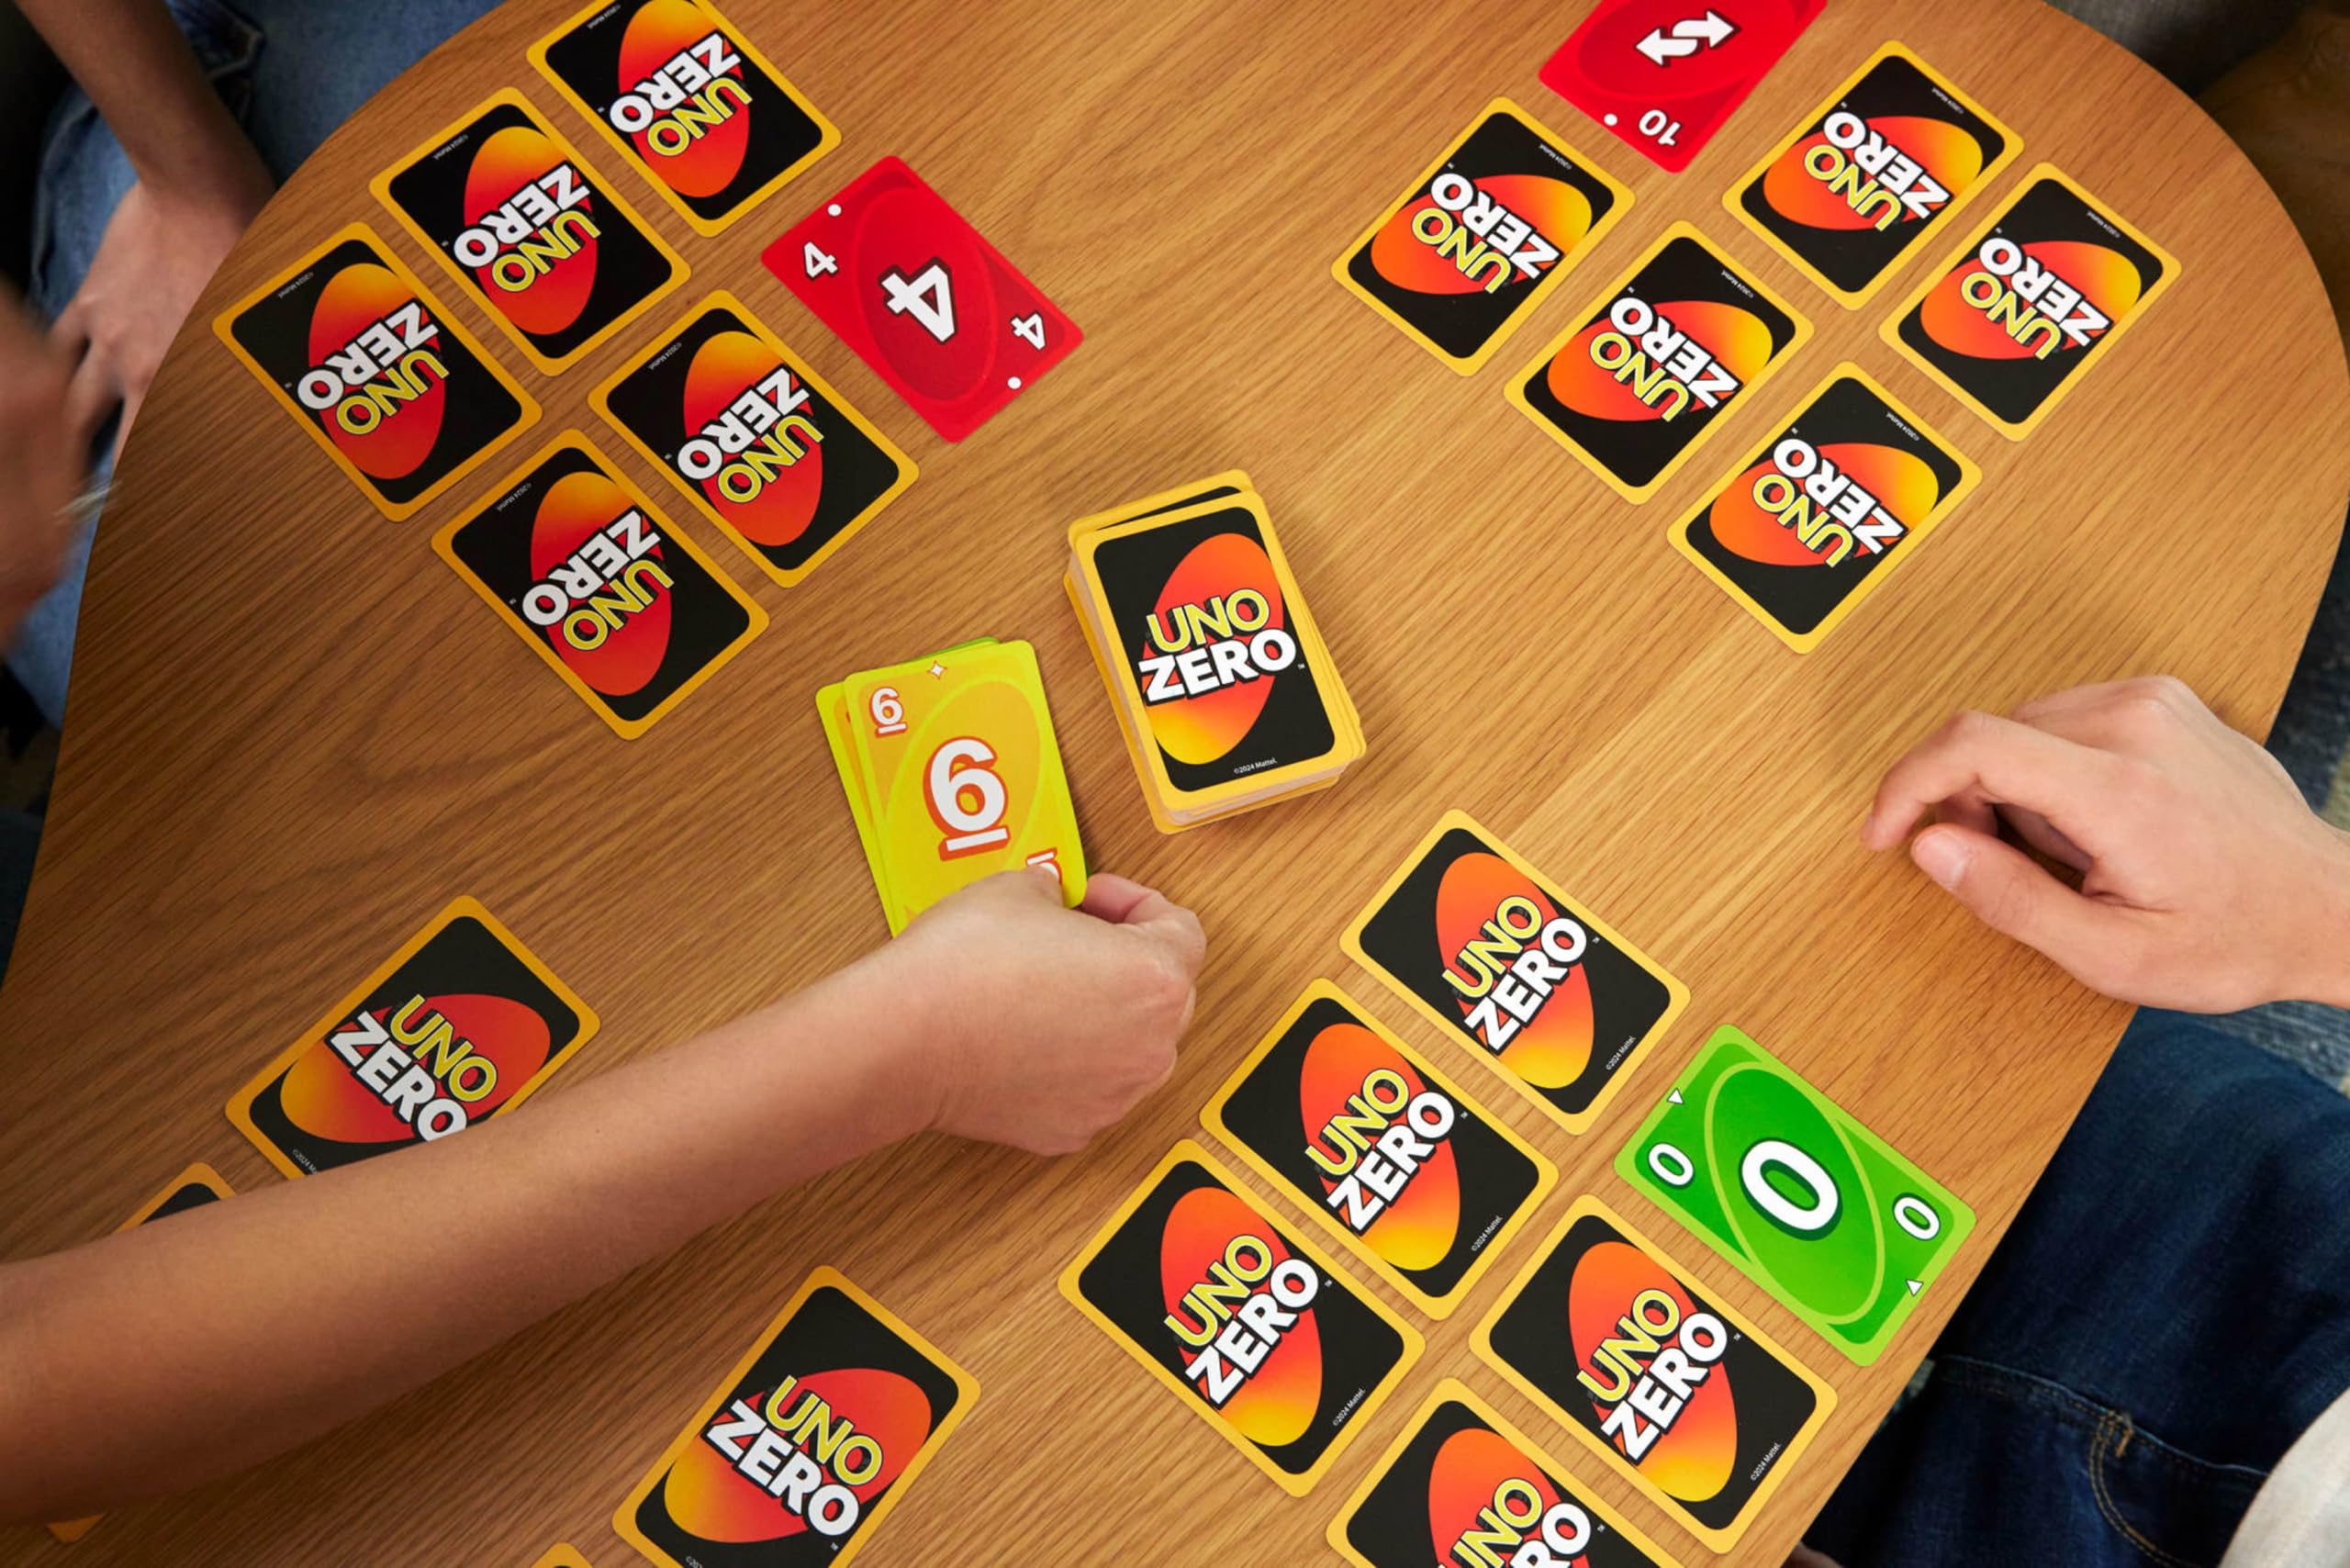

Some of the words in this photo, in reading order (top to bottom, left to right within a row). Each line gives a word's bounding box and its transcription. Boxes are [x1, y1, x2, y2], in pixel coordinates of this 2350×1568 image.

[609, 32, 742, 133] ZERO
[646, 76, 751, 157] UNO
[1638, 108, 1682, 147] 10
[1804, 144, 1902, 233] UNO
[1823, 111, 1951, 220] ZERO
[453, 163, 591, 268] ZERO
[491, 209, 601, 293] UNO
[804, 242, 837, 277] 4
[1412, 207, 1511, 293] UNO
[1429, 172, 1561, 280] ZERO
[881, 264, 955, 342] 4
[1011, 313, 1046, 349] 4
[1961, 271, 2061, 359] UNO
[1978, 237, 2110, 347] ZERO
[297, 302, 439, 410] ZERO
[336, 350, 450, 434] UNO
[1590, 331, 1689, 421] UNO
[1609, 297, 1740, 409] ZERO
[677, 367, 811, 480] ZERO
[717, 414, 823, 504] UNO
[1752, 474, 1853, 566] UNO
[1773, 437, 1905, 555] ZERO
[521, 510, 661, 626] ZERO
[562, 557, 673, 652] UNO
[1137, 628, 1297, 703] ZERO
[1147, 588, 1270, 653] UNO
[871, 687, 907, 735] 6
[929, 737, 1009, 853] 6
[1234, 764, 1255, 773] ©2024
[1255, 757, 1277, 767] Mattel.
[1443, 896, 1541, 998] UNO
[1462, 917, 1588, 1051] ZERO
[330, 1010, 469, 1143] ZERO
[390, 994, 497, 1102] UNO
[1606, 1053, 1621, 1070] ©2024
[1305, 1069, 1409, 1176] UNO
[1326, 1091, 1456, 1231] ZERO
[1649, 1143, 1694, 1185] 0
[1741, 1140, 1838, 1230] 0
[1894, 1197, 1940, 1239] 0
[1472, 1233, 1487, 1250] ©2024
[1164, 1235, 1272, 1347] UNO
[1184, 1258, 1320, 1406] ZERO
[1578, 1290, 1680, 1402] UNO
[1599, 1312, 1729, 1461] ZERO
[765, 1374, 883, 1486] UNO
[1333, 1406, 1349, 1426] ©2024
[706, 1398, 860, 1537] ZERO
[1751, 1462, 1766, 1480] ©2024
